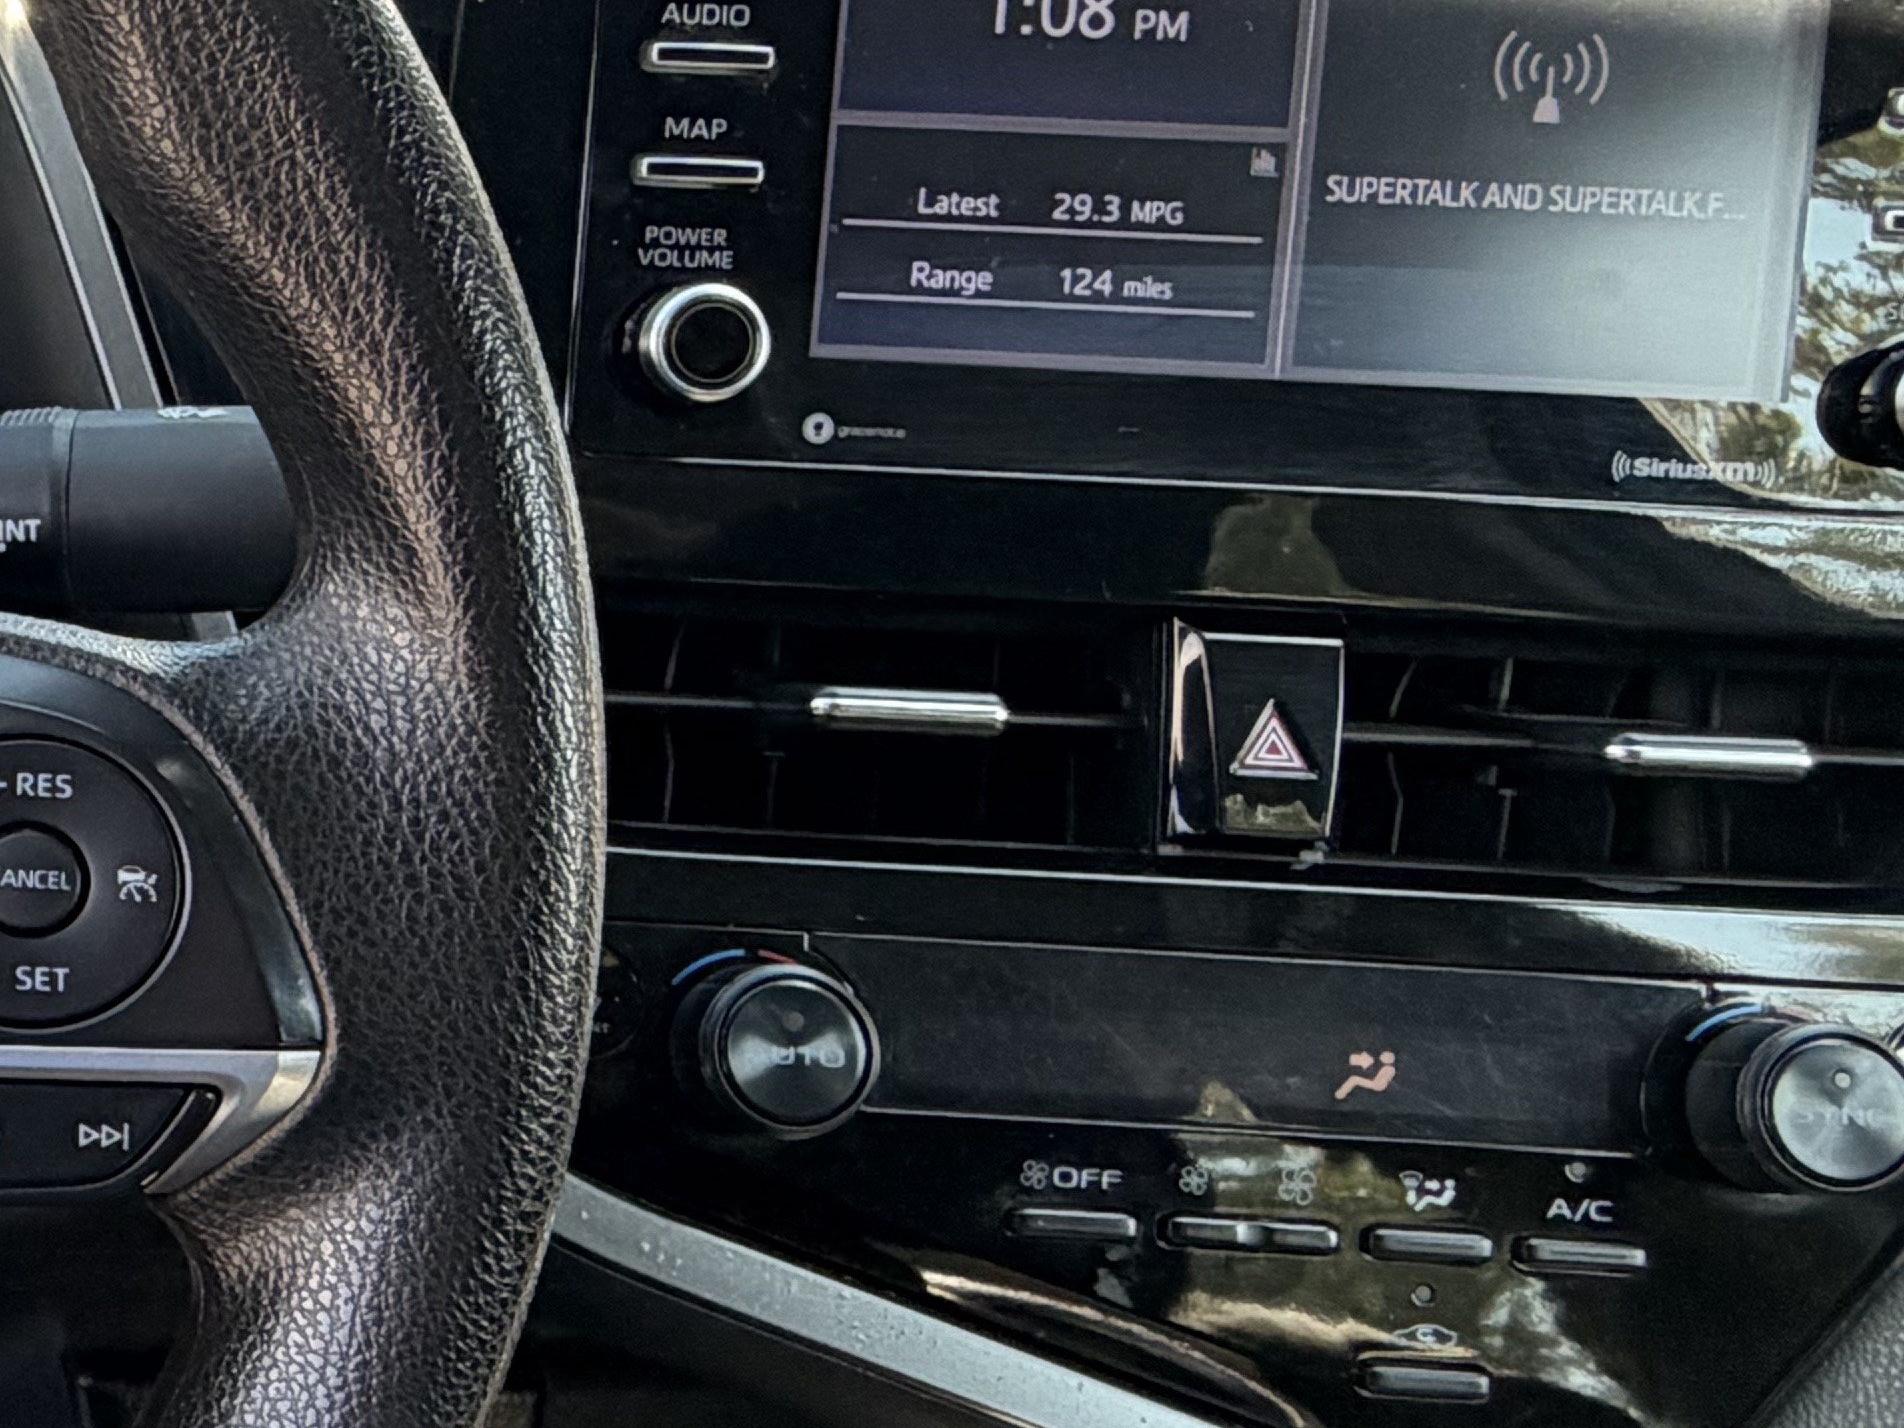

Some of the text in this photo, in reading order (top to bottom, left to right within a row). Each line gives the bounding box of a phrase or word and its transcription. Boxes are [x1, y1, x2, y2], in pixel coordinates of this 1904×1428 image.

[661, 3, 750, 29] AUDIO
[1134, 9, 1189, 41] PM
[665, 117, 727, 139] MAP
[1325, 175, 1480, 208] SUPERTALK
[1483, 183, 1543, 211] AND
[918, 187, 1183, 225] Latest 29.3 MPG
[645, 226, 727, 246] POWER
[638, 248, 733, 269] VOLUME
[911, 261, 1173, 299] Range 124 miles
[17, 773, 72, 798] RES
[16, 967, 69, 991] SET
[745, 1045, 845, 1068] UTO
[1053, 1167, 1122, 1189] OFF
[1547, 1198, 1613, 1221] A/C
